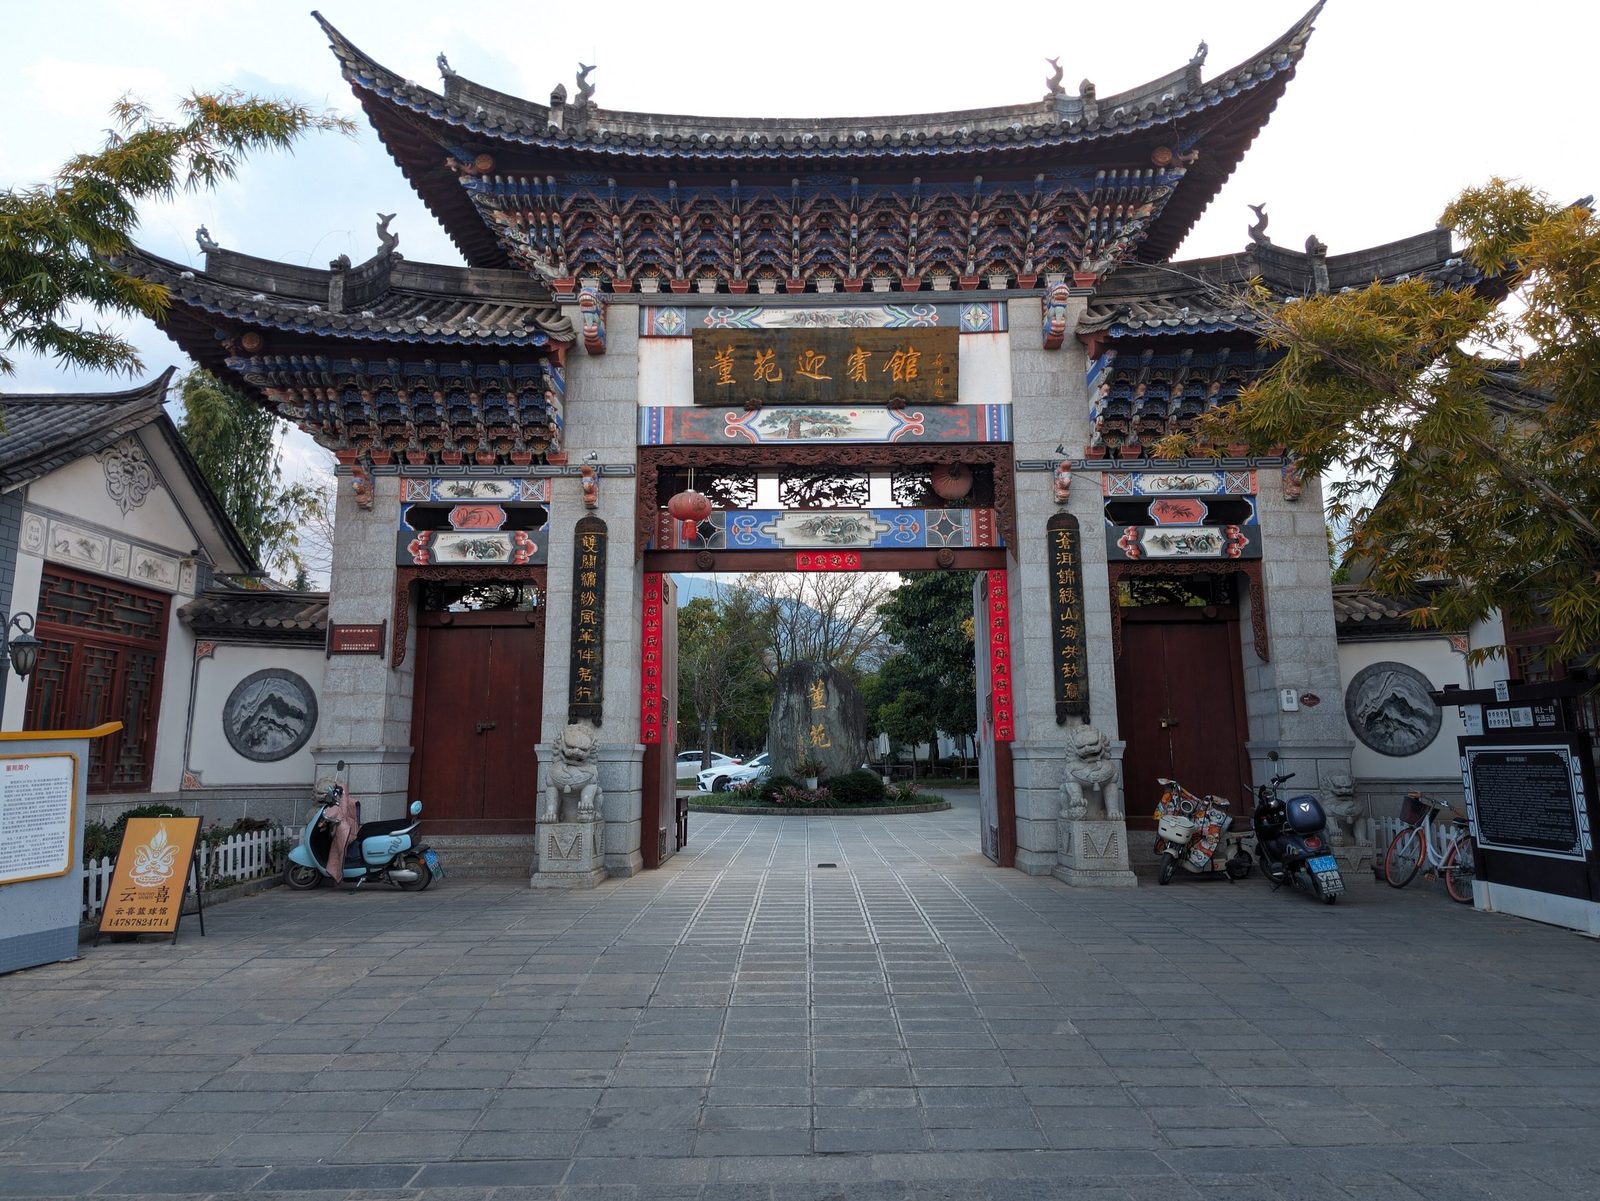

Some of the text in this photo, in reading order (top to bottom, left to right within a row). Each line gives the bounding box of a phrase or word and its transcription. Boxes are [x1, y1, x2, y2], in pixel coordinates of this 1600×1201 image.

[709, 344, 922, 386] 董苑迎賓館
[807, 678, 832, 749] 董苑
[120, 886, 137, 902] 云
[155, 885, 170, 903] 喜
[115, 907, 169, 916] 云喜篮球馆
[108, 918, 170, 927] 14787824714
